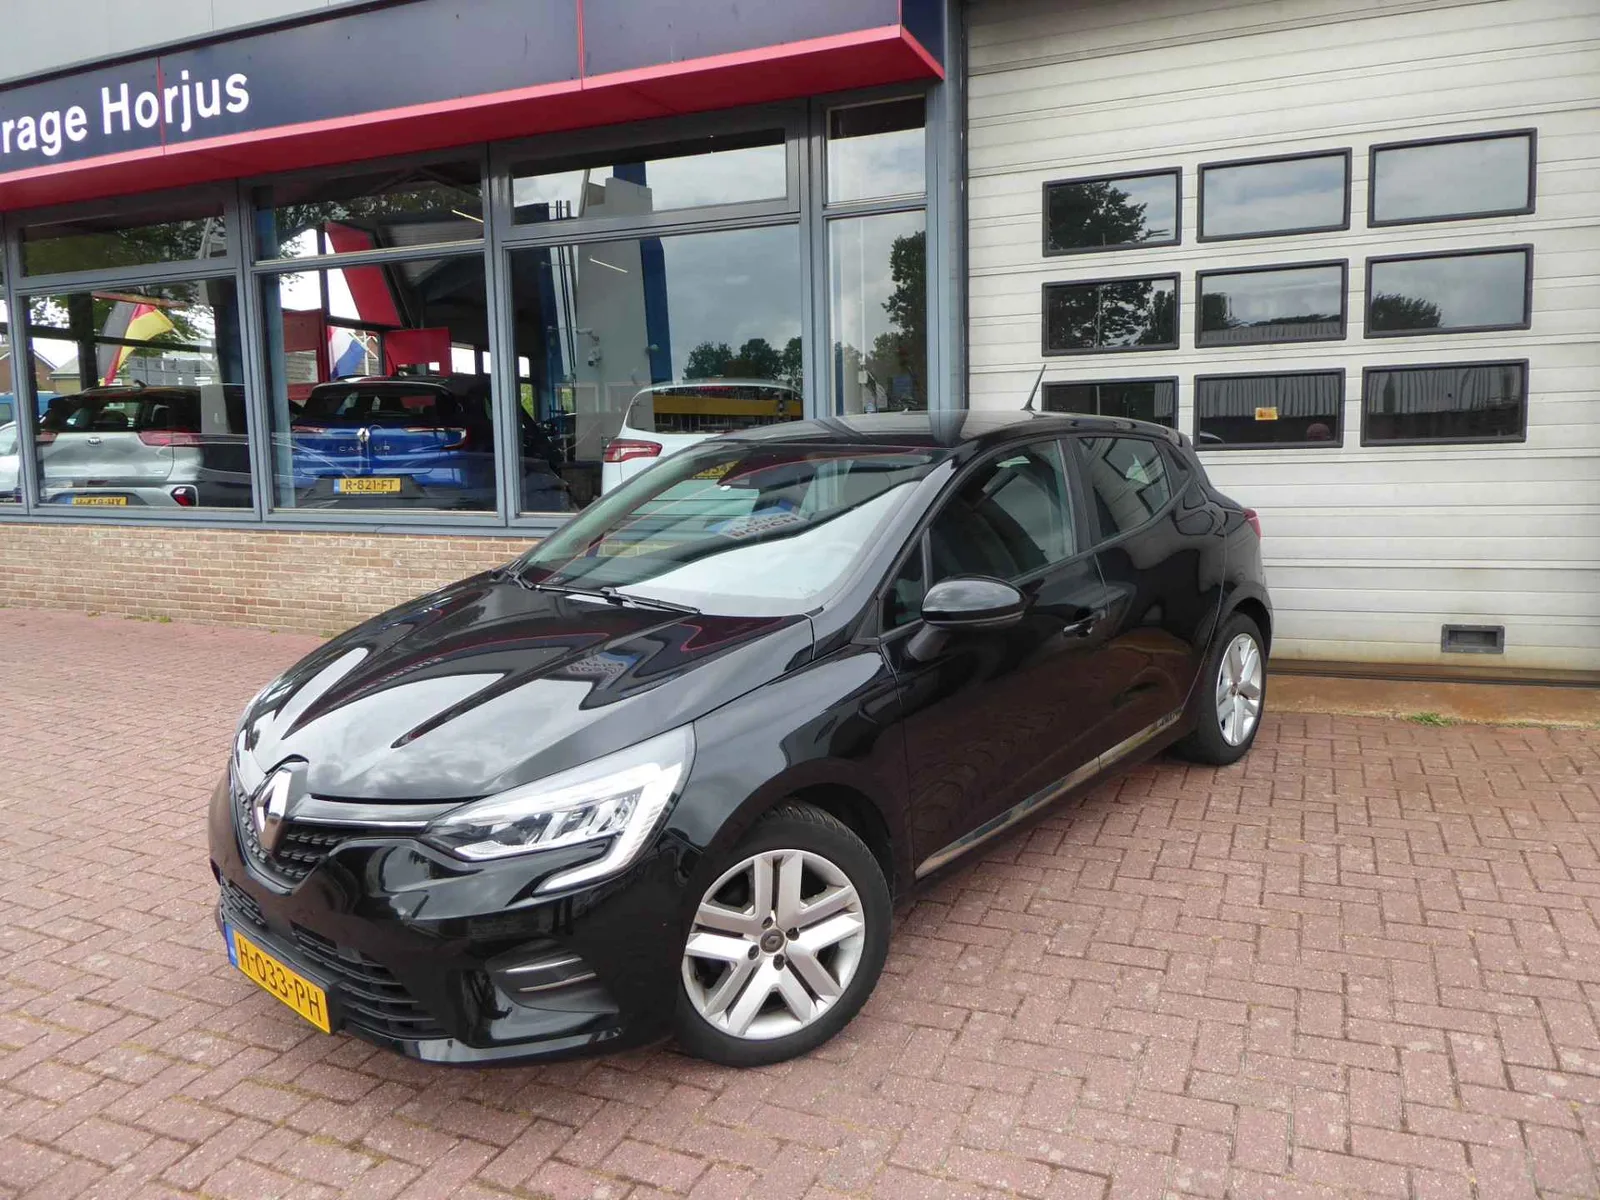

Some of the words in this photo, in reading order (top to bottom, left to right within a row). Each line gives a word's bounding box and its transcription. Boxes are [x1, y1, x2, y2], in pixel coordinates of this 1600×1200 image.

[1, 105, 88, 156] rage
[101, 69, 249, 135] Horjus
[345, 479, 395, 490] R-821-FT
[238, 938, 322, 1022] H-033-PH
